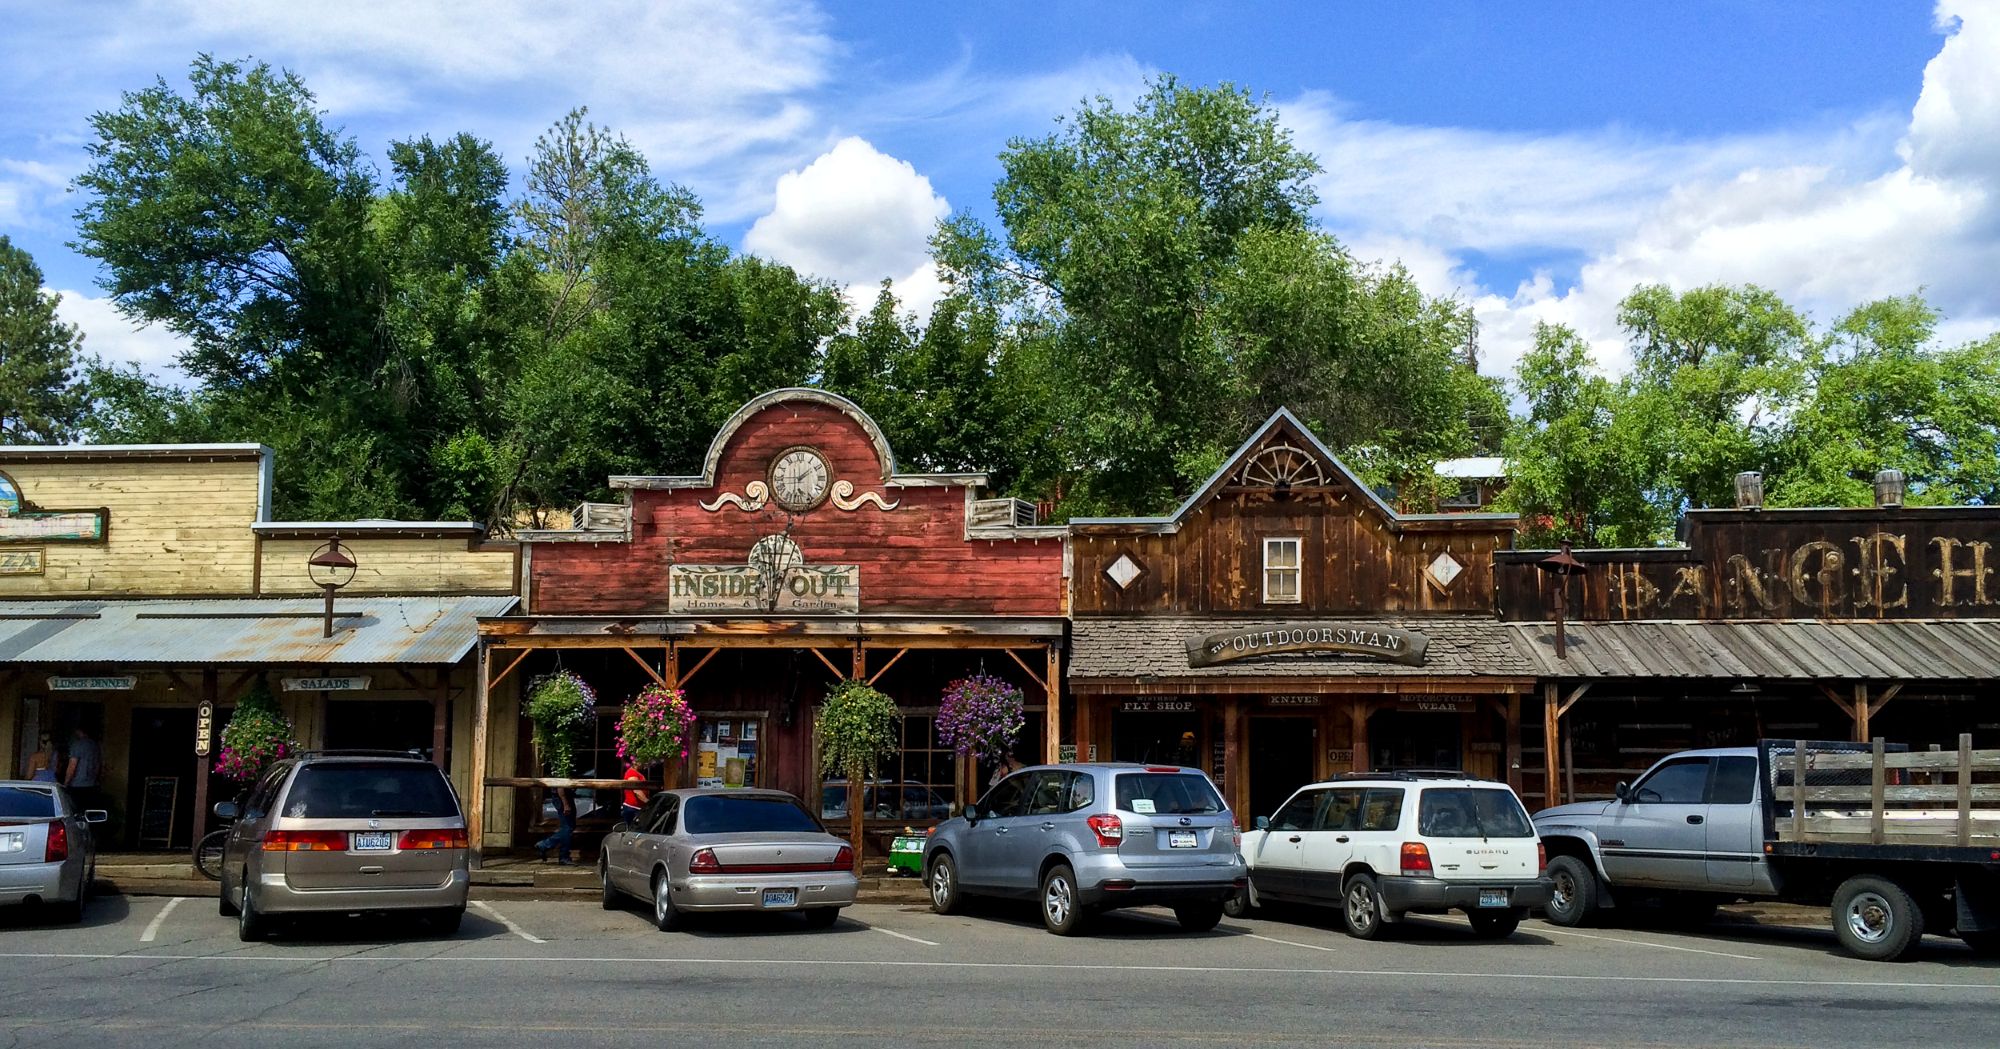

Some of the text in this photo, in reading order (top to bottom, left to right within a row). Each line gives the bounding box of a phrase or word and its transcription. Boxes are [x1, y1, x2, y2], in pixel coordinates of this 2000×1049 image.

[1929, 536, 1999, 606] H
[672, 575, 850, 597] INSIDE OUT
[687, 600, 726, 608] Home
[792, 600, 837, 608] Garden
[1210, 628, 1400, 654] THE OUTDOORSMAN
[301, 680, 350, 689] SALADS
[1124, 702, 1192, 710] FLY SHOP
[1271, 695, 1319, 704] KNIVES
[197, 706, 210, 750] OPEN
